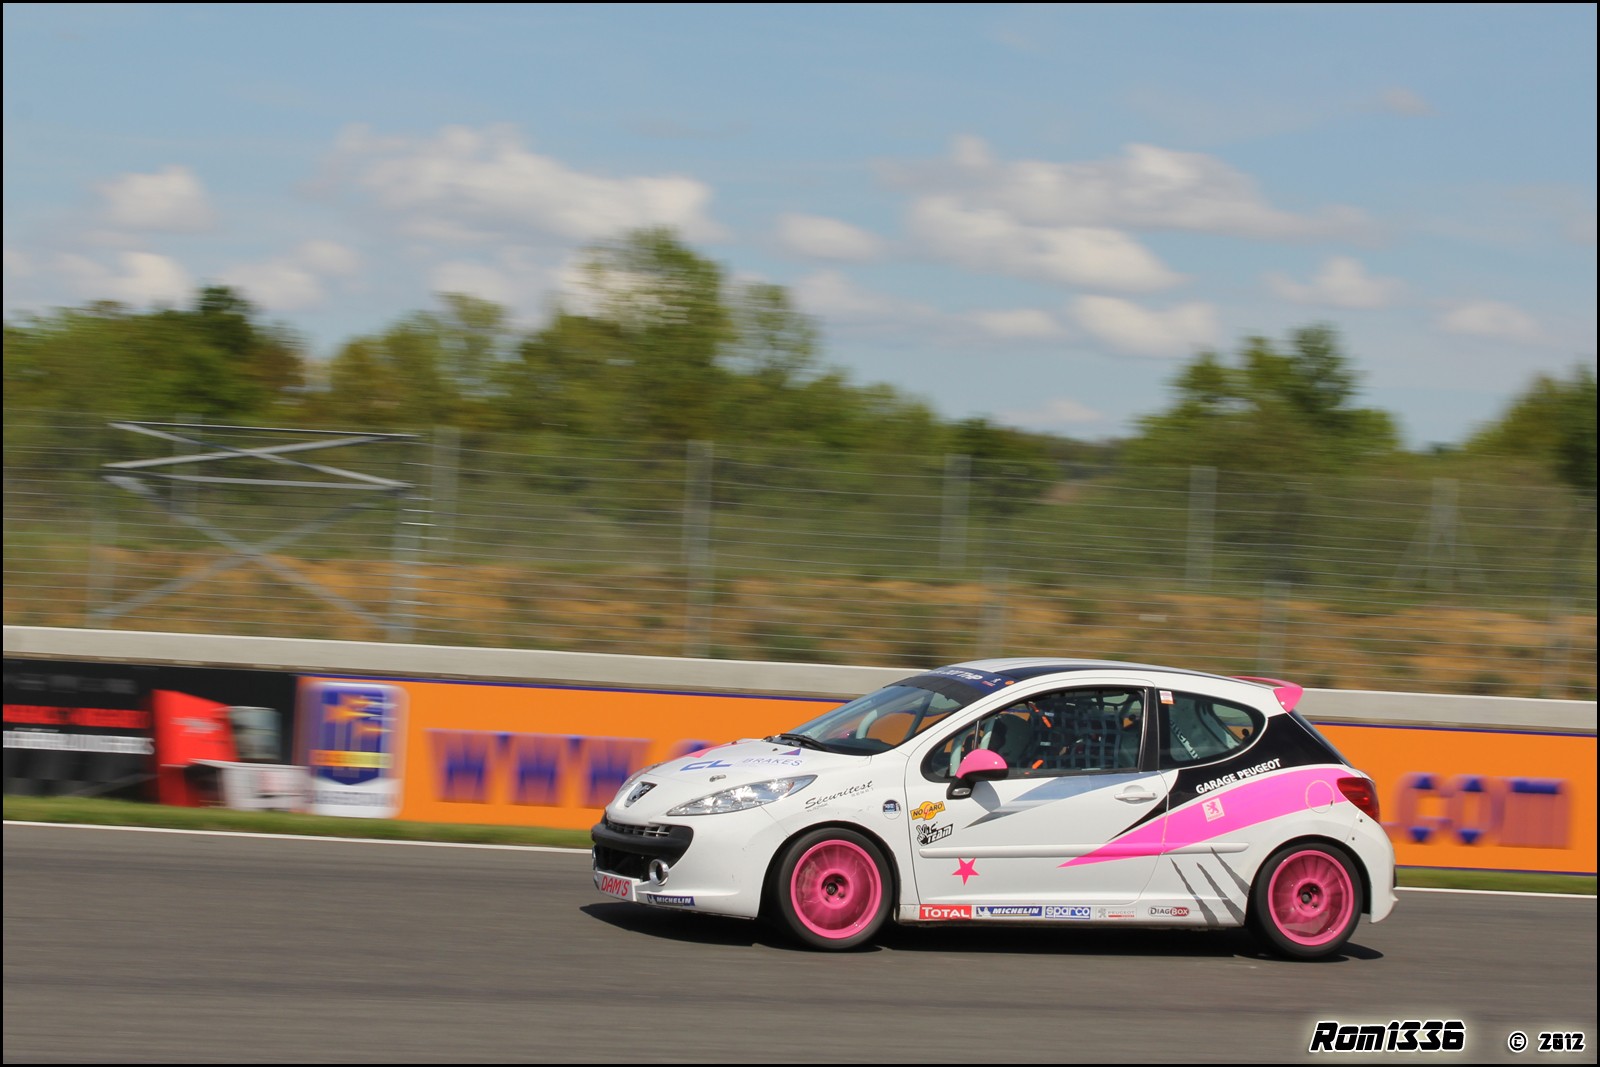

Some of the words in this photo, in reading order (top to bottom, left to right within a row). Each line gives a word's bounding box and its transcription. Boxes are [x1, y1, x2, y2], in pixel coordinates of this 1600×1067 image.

[680, 760, 732, 771] CL
[742, 757, 802, 767] BRAKES
[1196, 773, 1236, 794] GARAGE
[1236, 758, 1281, 779] PEUGEOT
[913, 803, 943, 818] NOGARO
[601, 875, 630, 897] DAM'S
[922, 907, 970, 918] TOTAL
[992, 907, 1040, 915] MICHELIN
[1046, 906, 1089, 918] sparco
